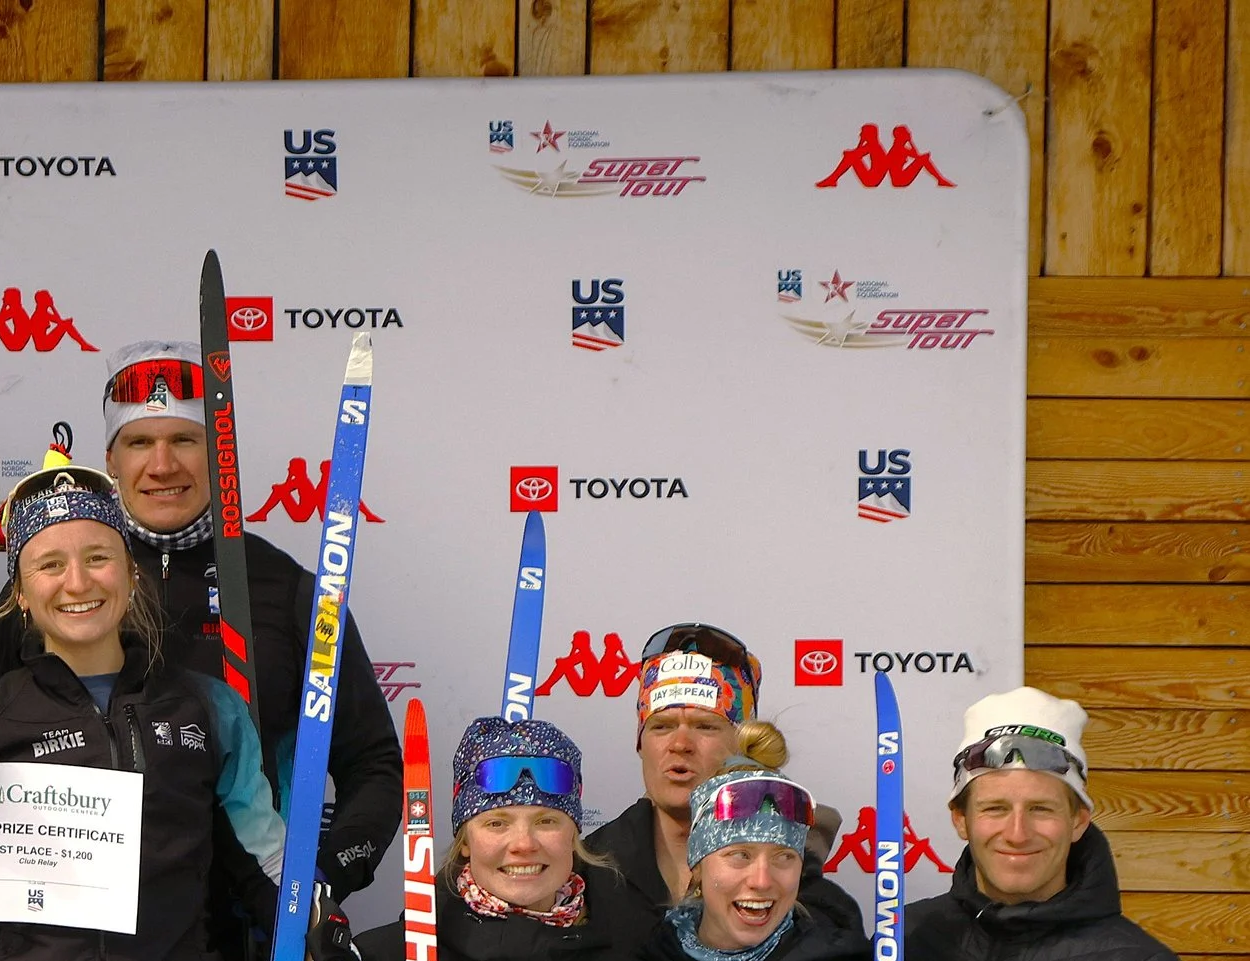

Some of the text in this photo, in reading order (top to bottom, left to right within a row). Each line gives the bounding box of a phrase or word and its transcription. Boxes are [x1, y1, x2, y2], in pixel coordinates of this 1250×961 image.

[488, 120, 515, 133] US
[283, 129, 337, 155] US
[778, 269, 802, 282] US
[572, 279, 625, 304] US
[284, 307, 404, 329] TOYOTA
[215, 401, 243, 538] ROSSIGNOL
[858, 449, 912, 475] US
[569, 477, 689, 499] TOYOTA
[304, 511, 353, 723] SALOMON
[660, 655, 710, 676] Colby
[854, 651, 975, 674] TOYOTA
[652, 687, 714, 703] JAY PEAK
[42, 727, 70, 738] TEAM
[32, 730, 87, 758] BIRKIE
[6, 784, 112, 817] Craftsbury
[70, 808, 99, 816] CENTER
[37, 825, 125, 845] CERTIFICATE
[16, 846, 53, 857] PLACE
[60, 849, 93, 862] $1,200
[19, 857, 58, 868] Club Relay
[28, 889, 44, 898] US
